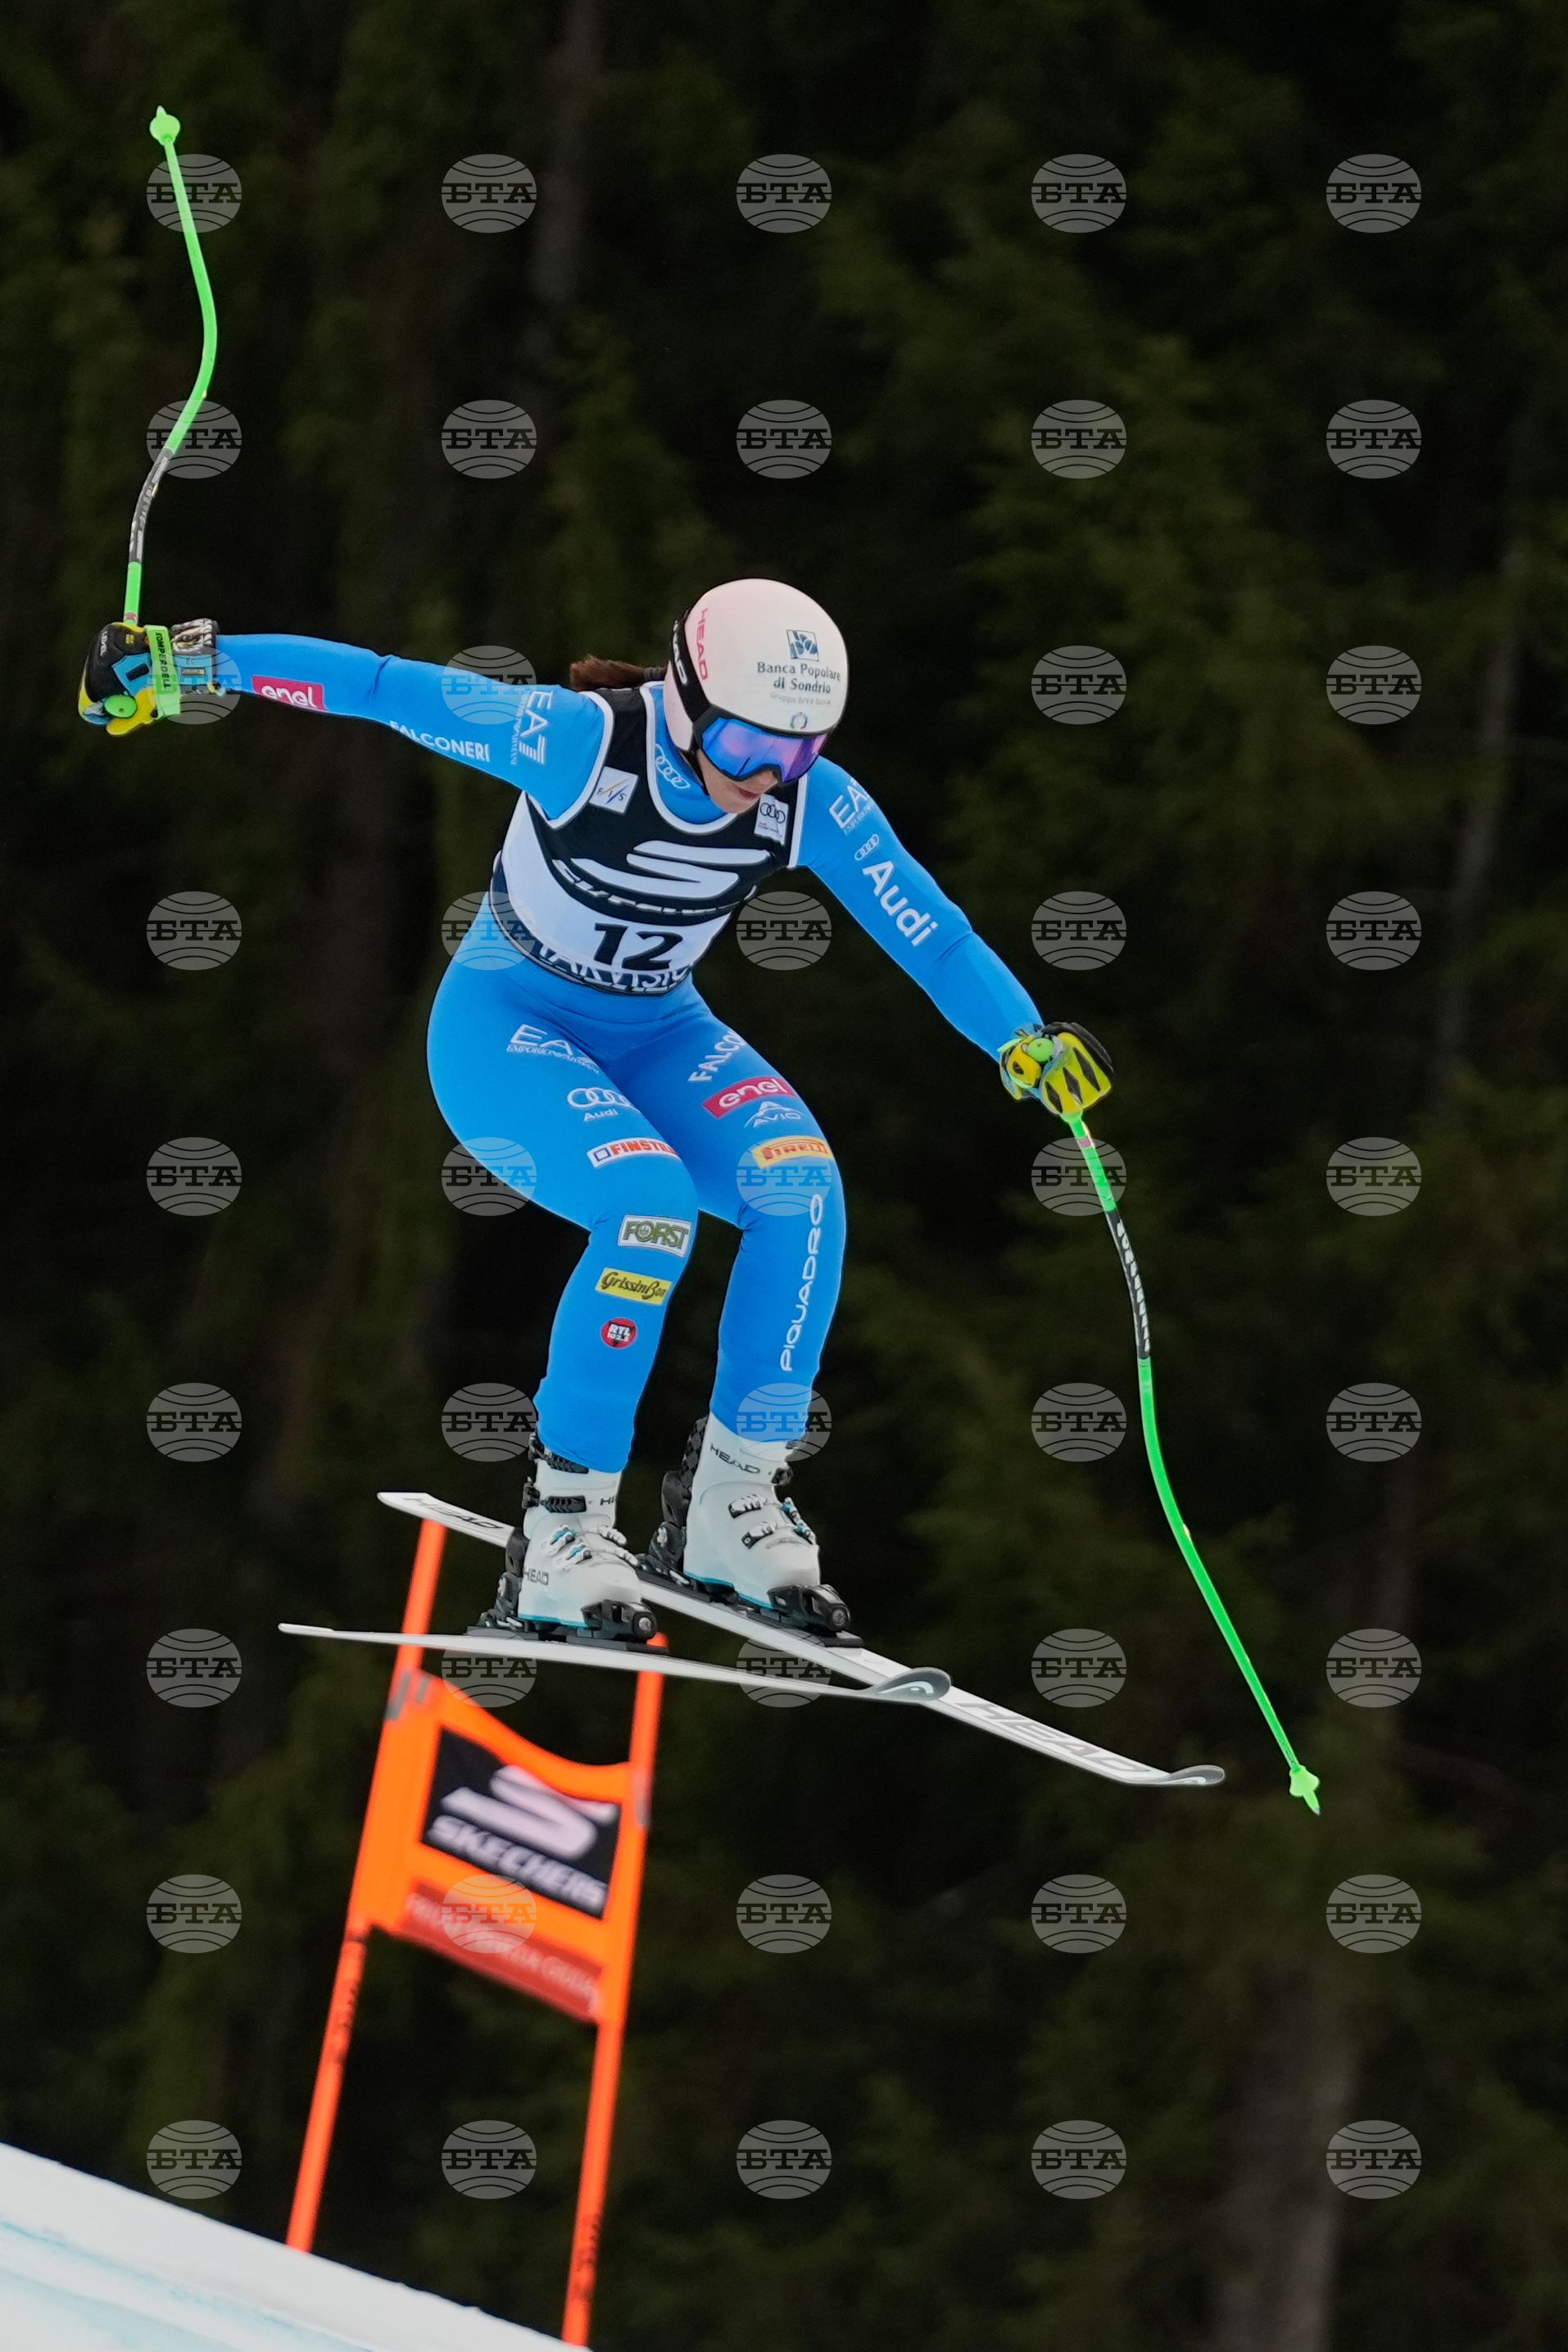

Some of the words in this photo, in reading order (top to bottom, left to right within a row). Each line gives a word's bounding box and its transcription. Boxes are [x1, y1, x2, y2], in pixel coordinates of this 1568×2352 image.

[696, 608, 708, 680] HEAD
[757, 662, 795, 673] Banca
[800, 664, 841, 681] Popolare
[773, 677, 785, 689] di
[791, 678, 831, 694] Sondrio
[261, 684, 318, 709] enel
[389, 720, 490, 763] FALCONERI
[863, 860, 939, 947] Audi
[594, 922, 683, 972] 12
[719, 1078, 788, 1108] enel
[584, 1108, 619, 1122] Audi
[753, 1113, 801, 1127] AVIO
[623, 1220, 689, 1249] FORST
[780, 1194, 823, 1371] PIQUADRO
[609, 1323, 631, 1337] RTL
[709, 1443, 760, 1474] HEAD
[402, 1497, 504, 1529] HEAD
[955, 1702, 1151, 1772] HEAD
